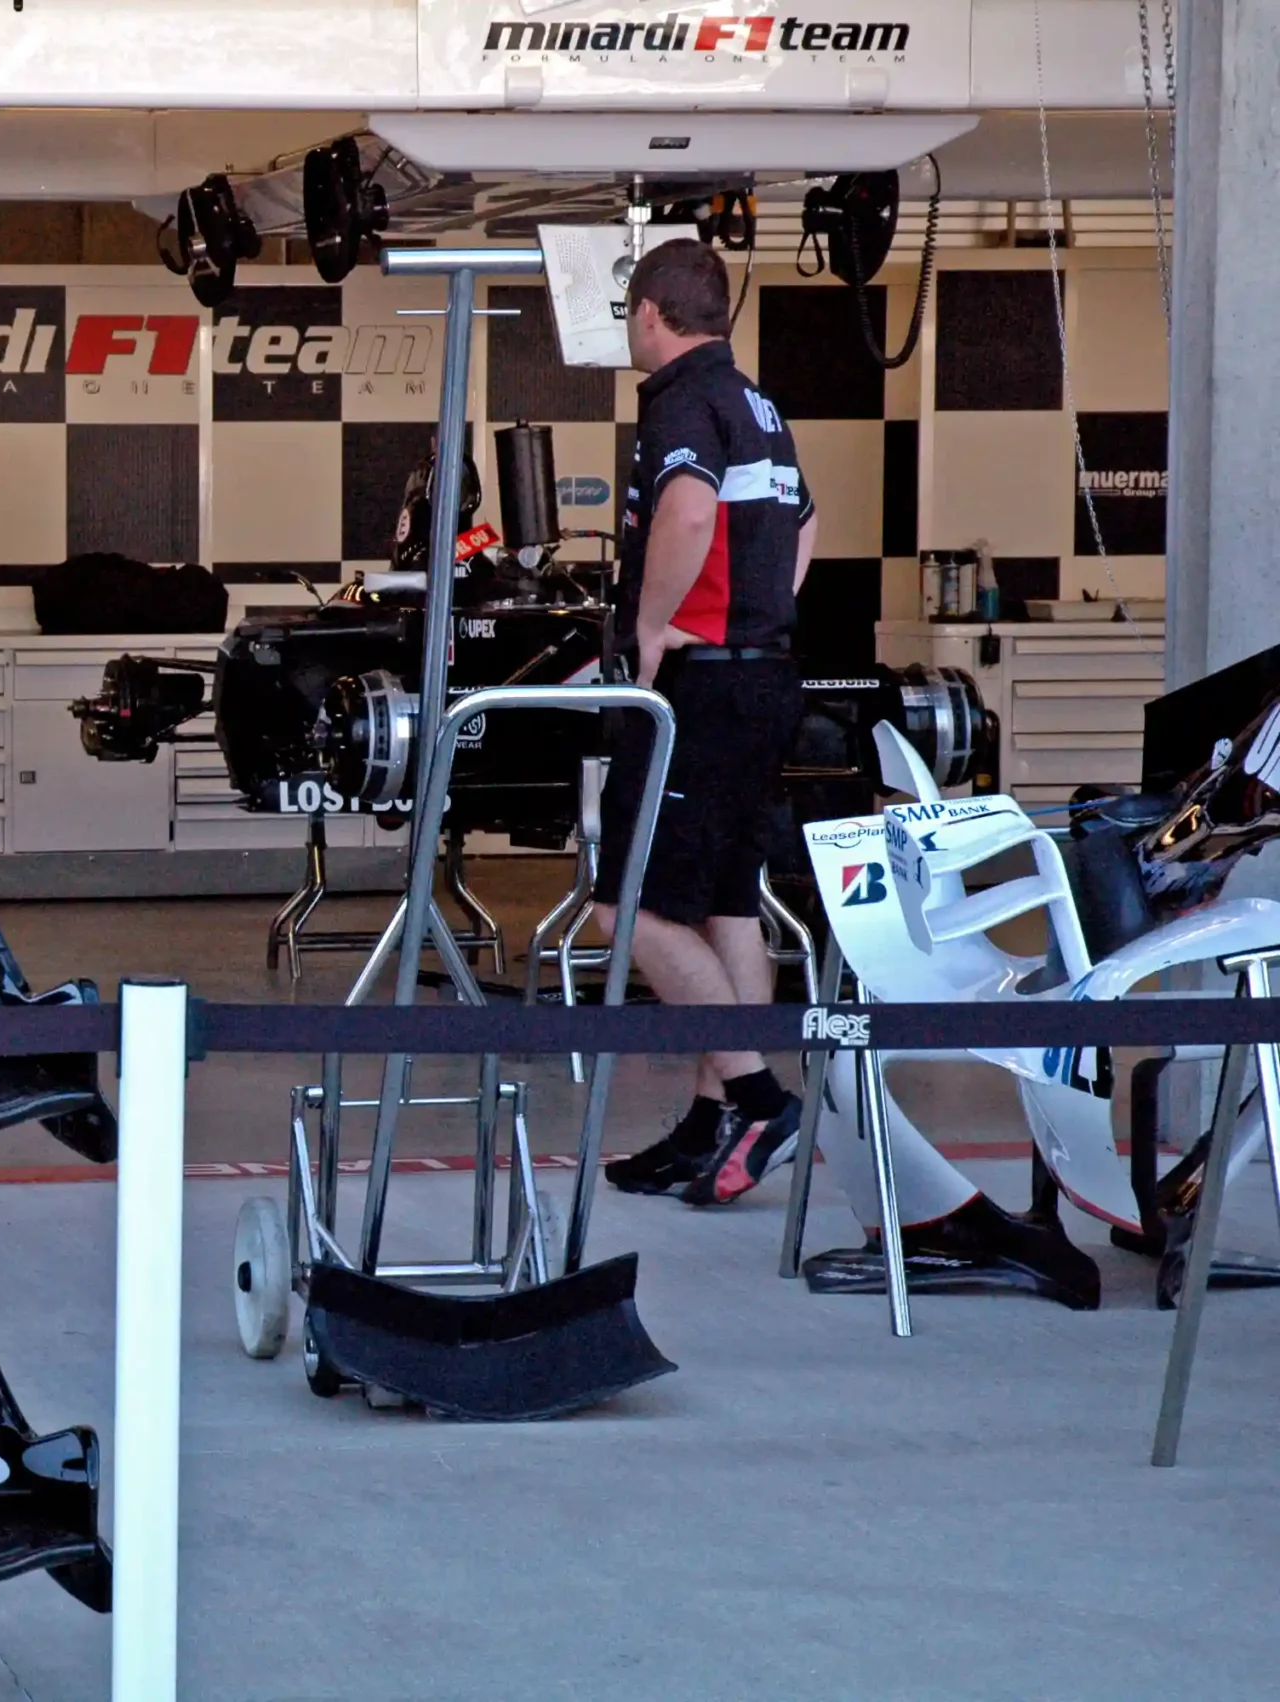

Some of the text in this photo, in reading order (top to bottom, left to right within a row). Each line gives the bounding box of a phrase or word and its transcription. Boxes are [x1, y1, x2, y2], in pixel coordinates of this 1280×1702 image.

[482, 53, 907, 63] FORMULA ONE TEAM
[1122, 488, 1157, 498] Group
[891, 802, 992, 824] SMP BANK
[885, 820, 908, 852] SMP
[802, 1007, 870, 1040] flex
